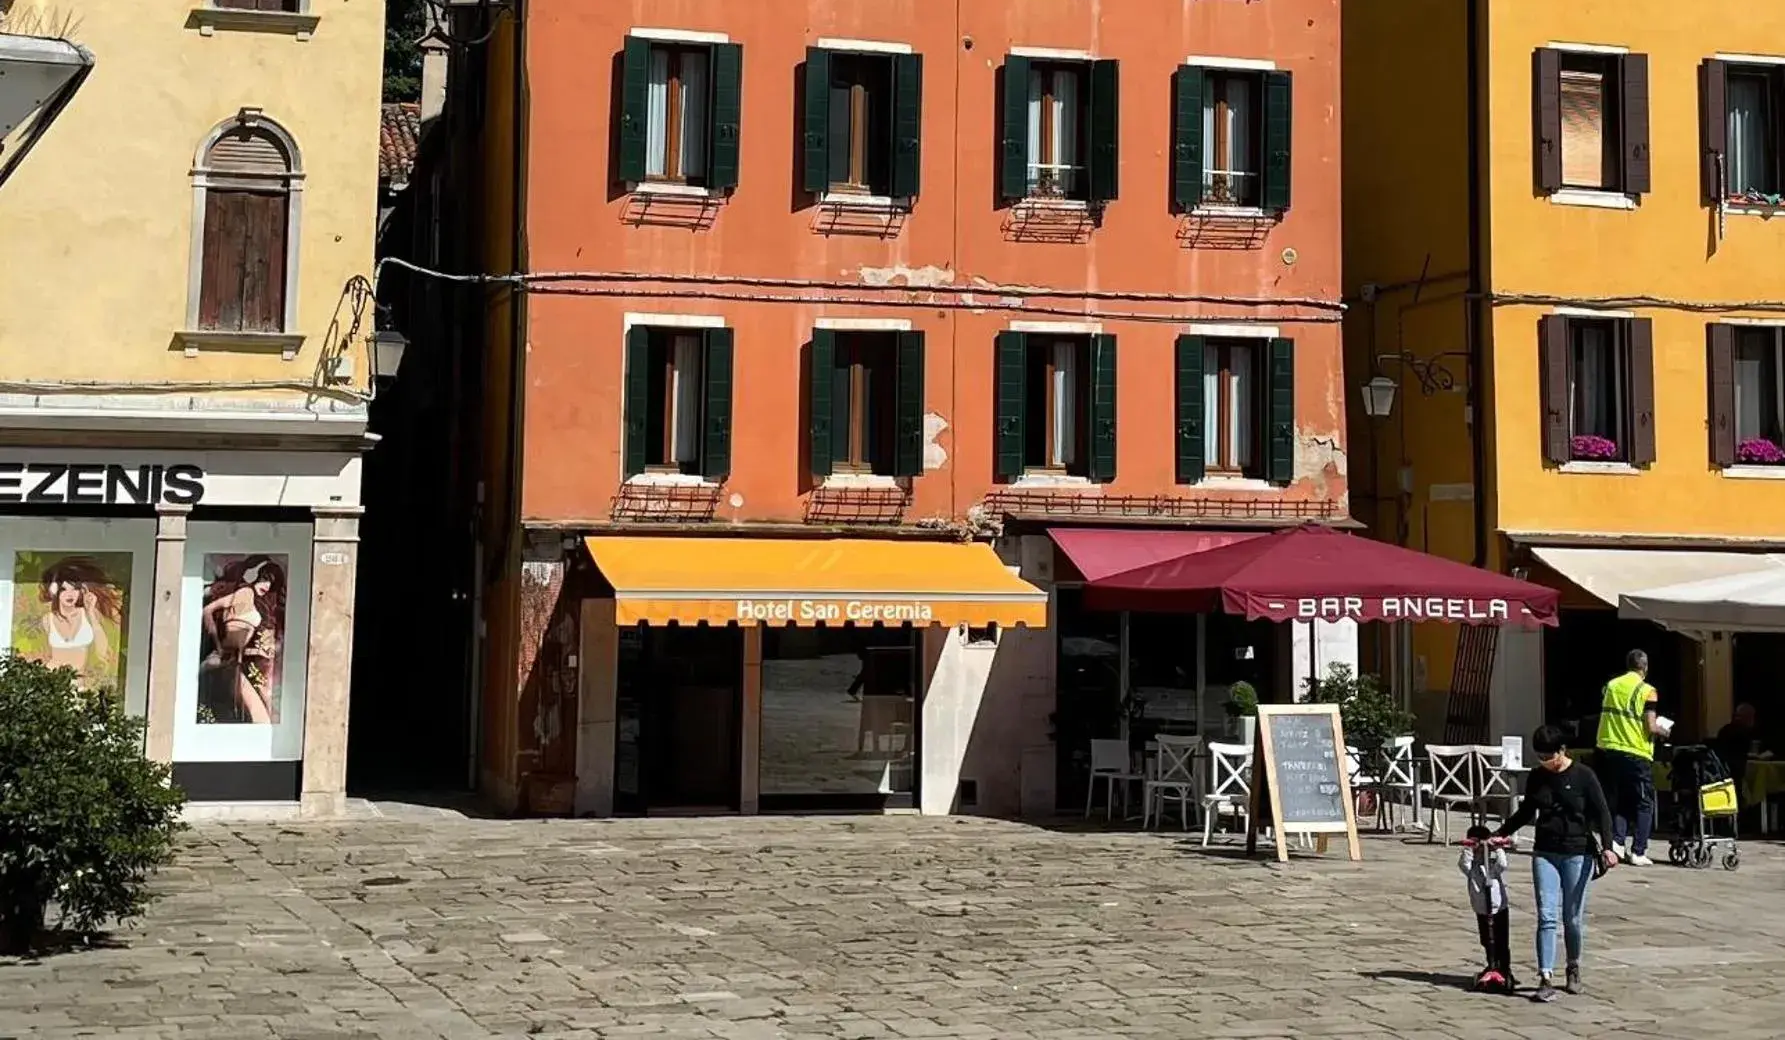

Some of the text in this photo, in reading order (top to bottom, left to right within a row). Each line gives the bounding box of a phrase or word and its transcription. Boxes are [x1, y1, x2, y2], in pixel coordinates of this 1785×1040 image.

[0, 463, 205, 504] EZENIS
[737, 600, 932, 620] Hotel San Geremia
[1298, 598, 1363, 617] BAR
[1382, 598, 1508, 619] ANGELA
